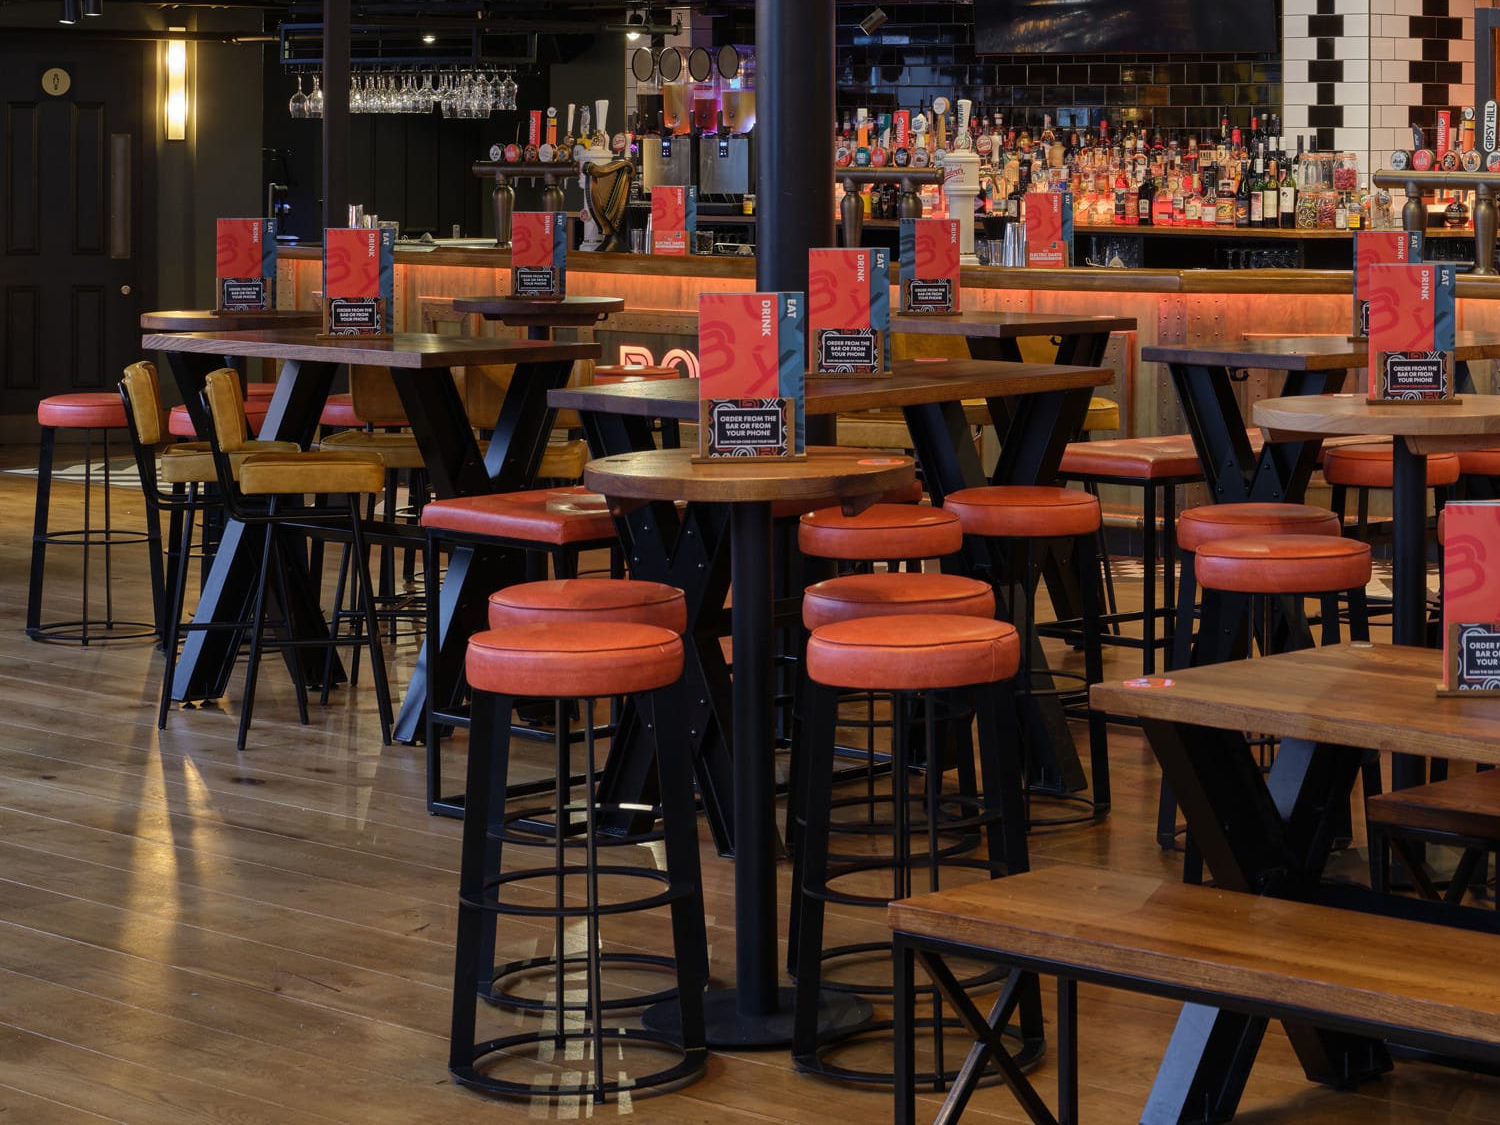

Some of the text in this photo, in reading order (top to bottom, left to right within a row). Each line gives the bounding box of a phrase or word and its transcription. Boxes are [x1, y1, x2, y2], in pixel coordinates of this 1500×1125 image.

[1485, 104, 1496, 151] GIPSY HILL
[857, 255, 865, 282] DRINK
[1442, 269, 1450, 286] EAT
[1421, 269, 1429, 300] DRINK
[761, 300, 772, 336] DRINK
[787, 299, 797, 318] EAT
